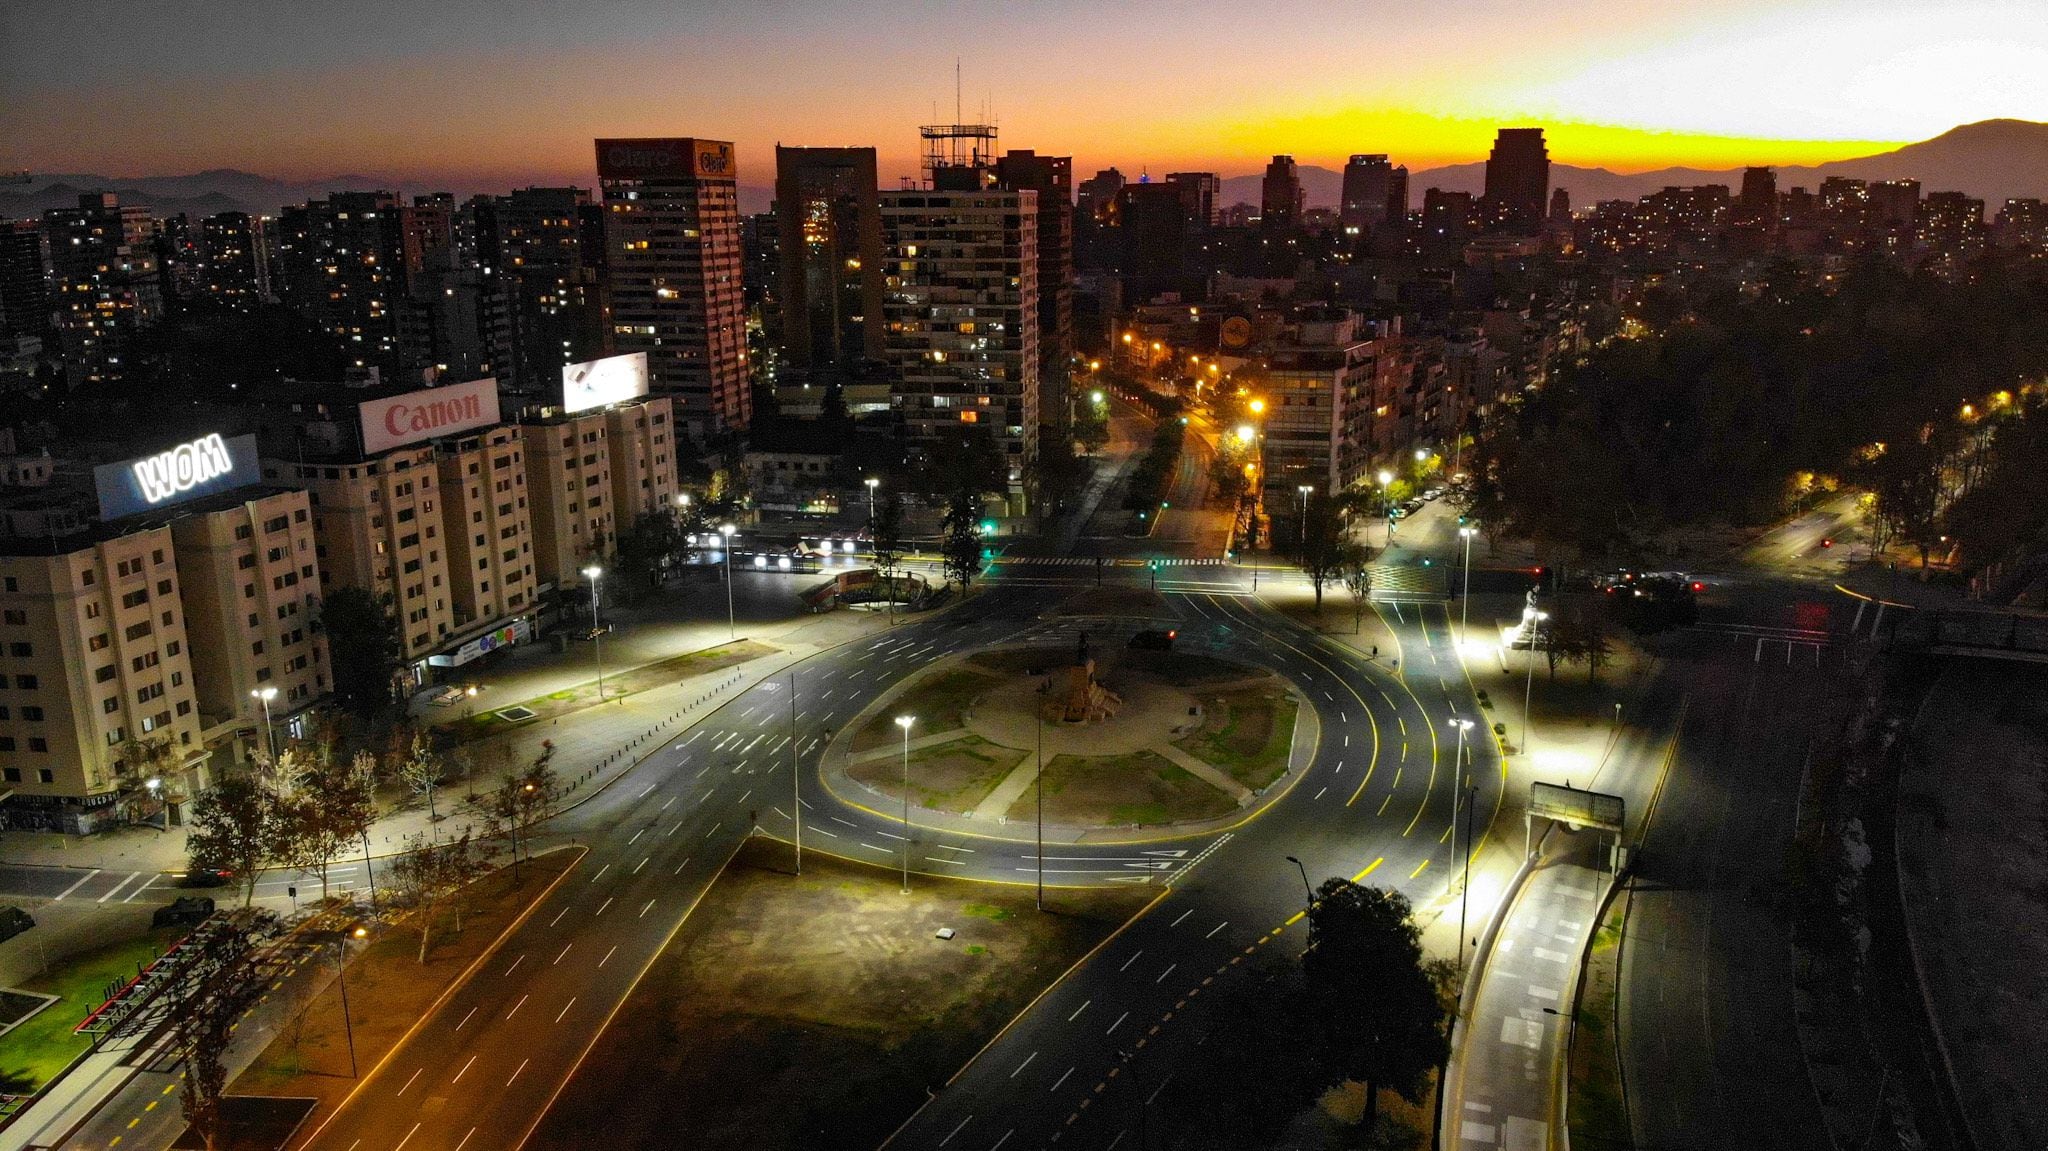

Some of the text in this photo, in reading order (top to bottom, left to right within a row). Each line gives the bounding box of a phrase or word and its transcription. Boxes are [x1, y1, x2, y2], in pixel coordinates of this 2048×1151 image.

[701, 152, 727, 172] Claro
[385, 394, 481, 436] Canon
[134, 432, 233, 503] WOM
